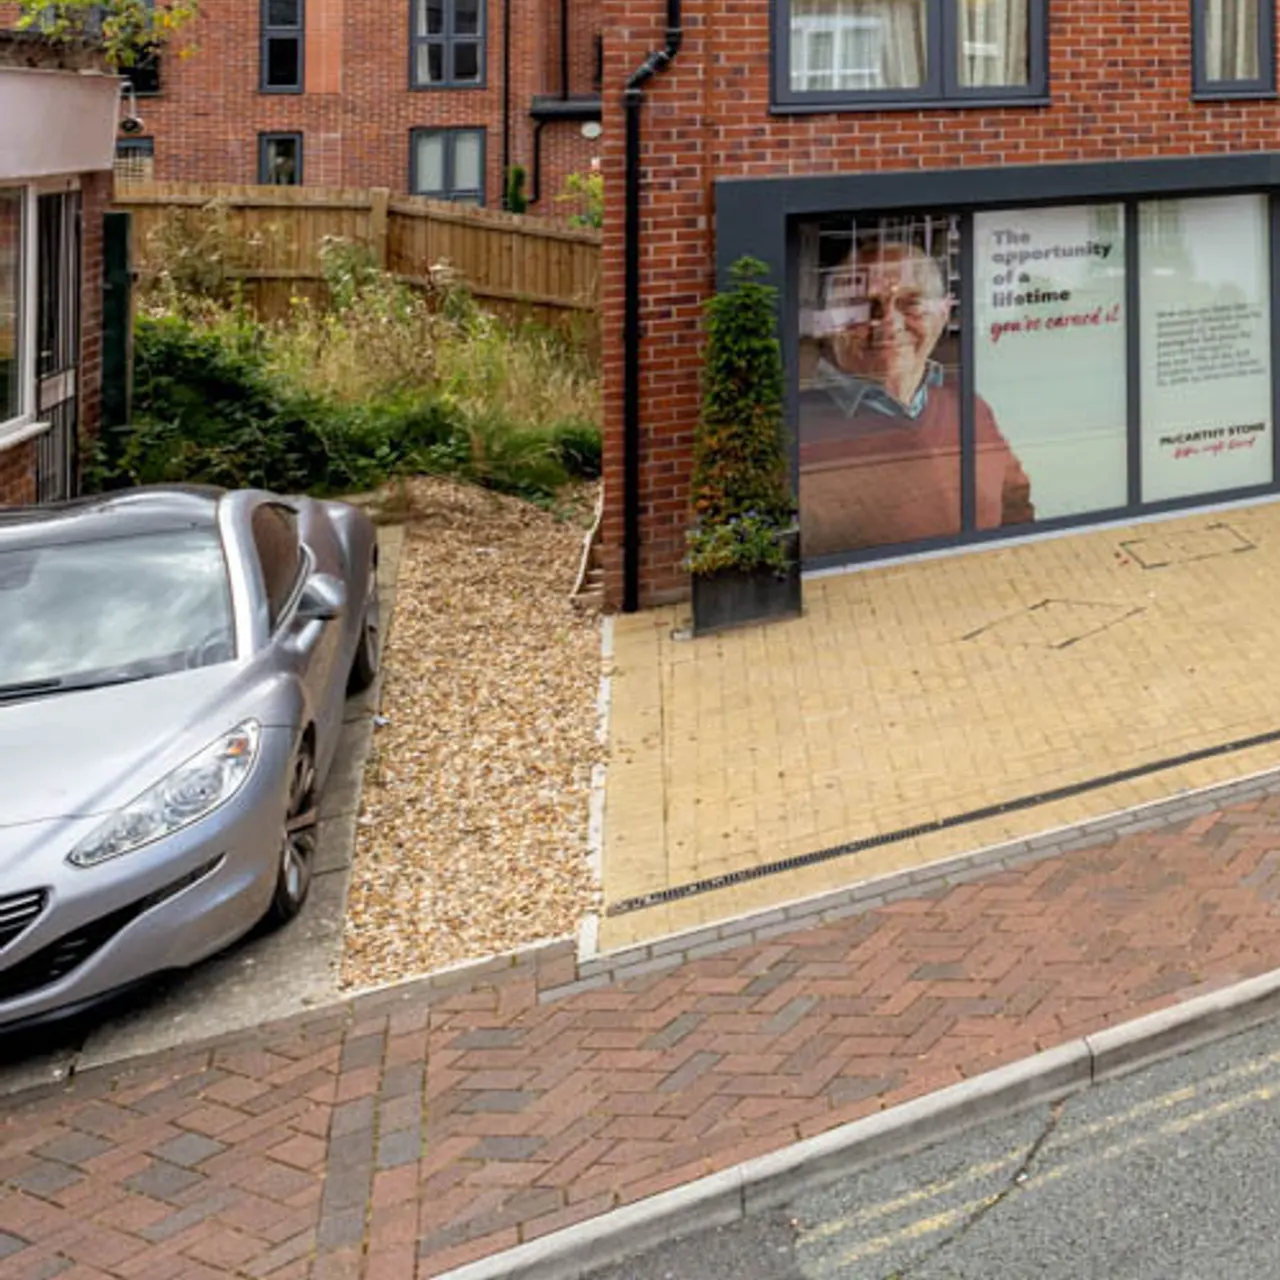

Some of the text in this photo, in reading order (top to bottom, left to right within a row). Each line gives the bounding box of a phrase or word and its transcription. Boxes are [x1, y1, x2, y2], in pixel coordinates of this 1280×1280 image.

[993, 230, 1030, 244] The
[992, 242, 1112, 266] opportunity
[993, 270, 1030, 285] of a
[993, 289, 1070, 307] lifetime
[1045, 308, 1102, 329] earned
